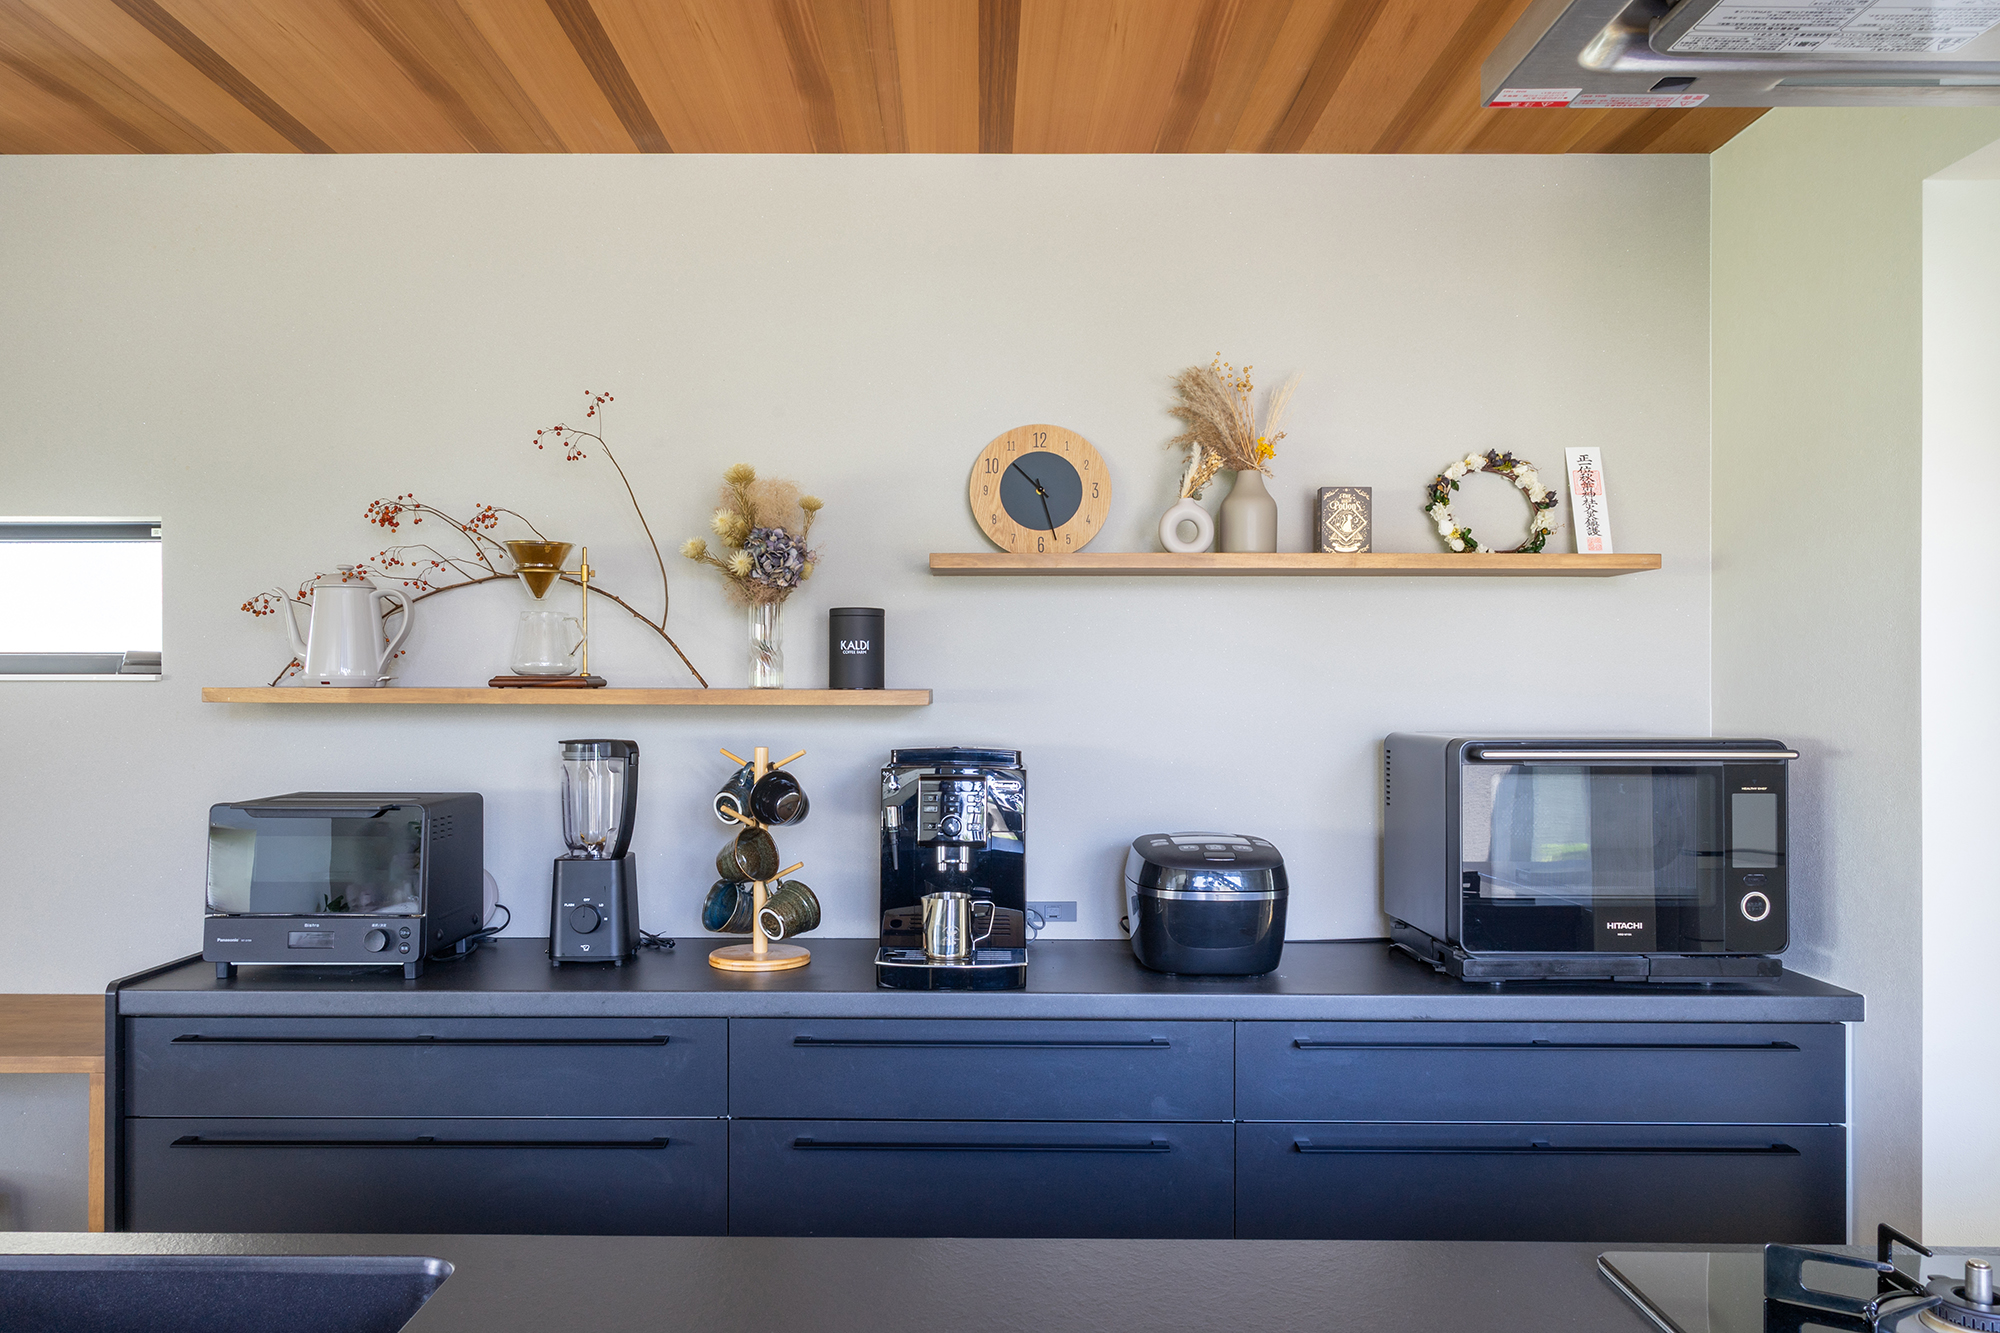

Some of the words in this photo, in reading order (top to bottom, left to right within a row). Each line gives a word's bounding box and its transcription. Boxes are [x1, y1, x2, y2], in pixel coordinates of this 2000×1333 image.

[1032, 431, 1047, 448] 12
[1006, 440, 1016, 451] 11
[1065, 440, 1070, 451] 1
[984, 457, 999, 474] 10
[1083, 459, 1090, 471] 2
[983, 485, 989, 496] 9
[1091, 482, 1099, 499] 3
[991, 513, 997, 525] 8
[1085, 514, 1091, 524] 4
[1010, 533, 1016, 544] 7
[1065, 533, 1071, 544] 5
[1037, 536, 1045, 553] 6
[840, 640, 870, 650] KALDI
[1606, 922, 1643, 930] HITACHI
